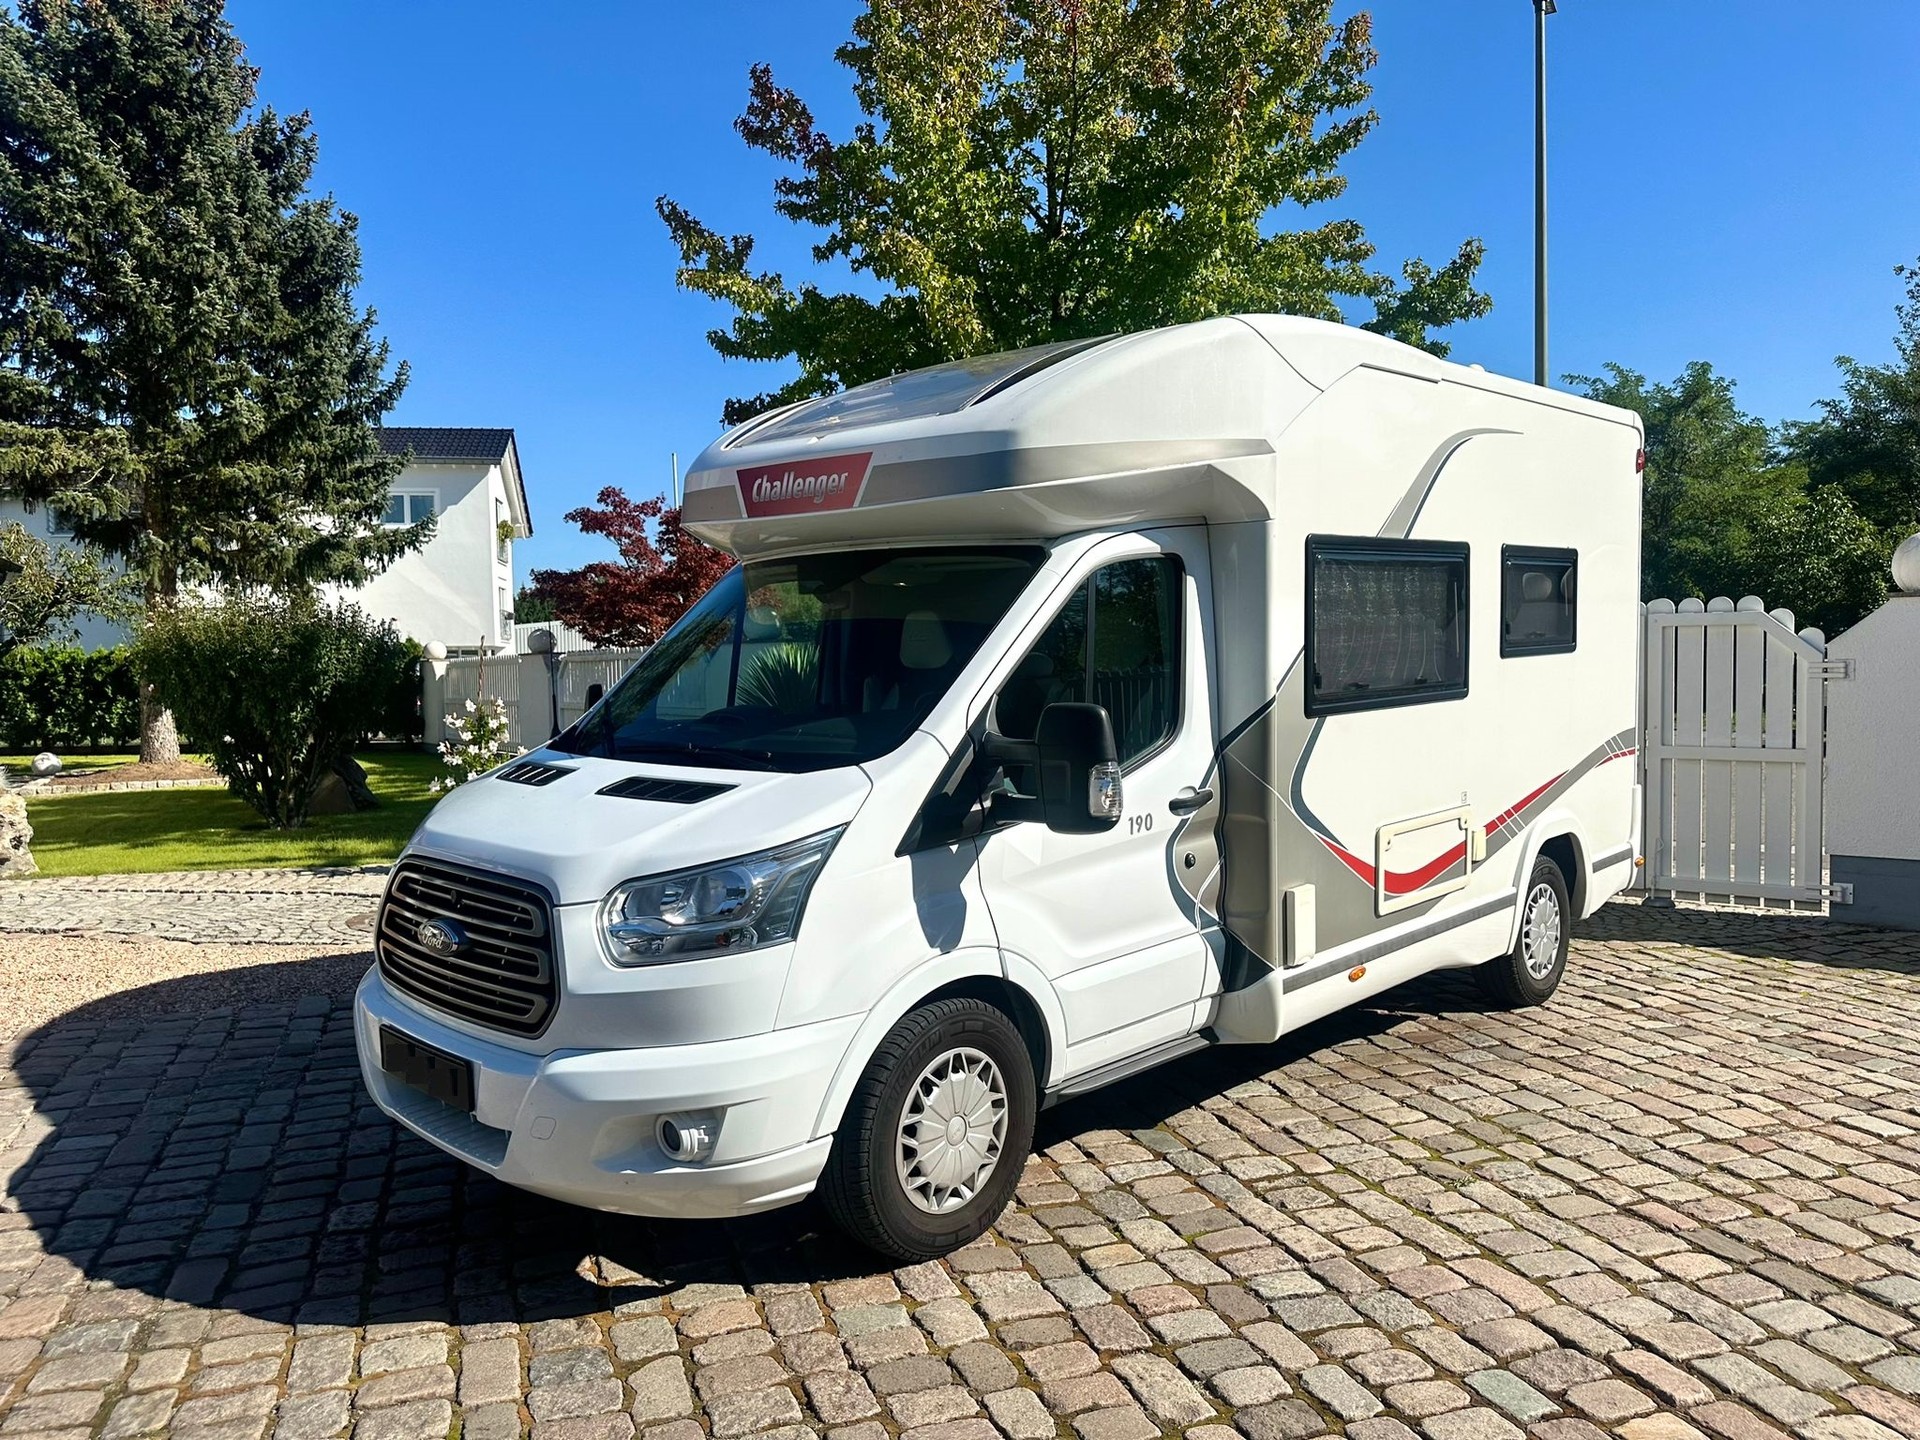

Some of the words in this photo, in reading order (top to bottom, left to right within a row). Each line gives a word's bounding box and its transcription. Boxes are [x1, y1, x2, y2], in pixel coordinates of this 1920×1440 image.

[752, 471, 849, 504] Challenger
[1128, 813, 1153, 835] 190
[421, 926, 443, 949] Ford
